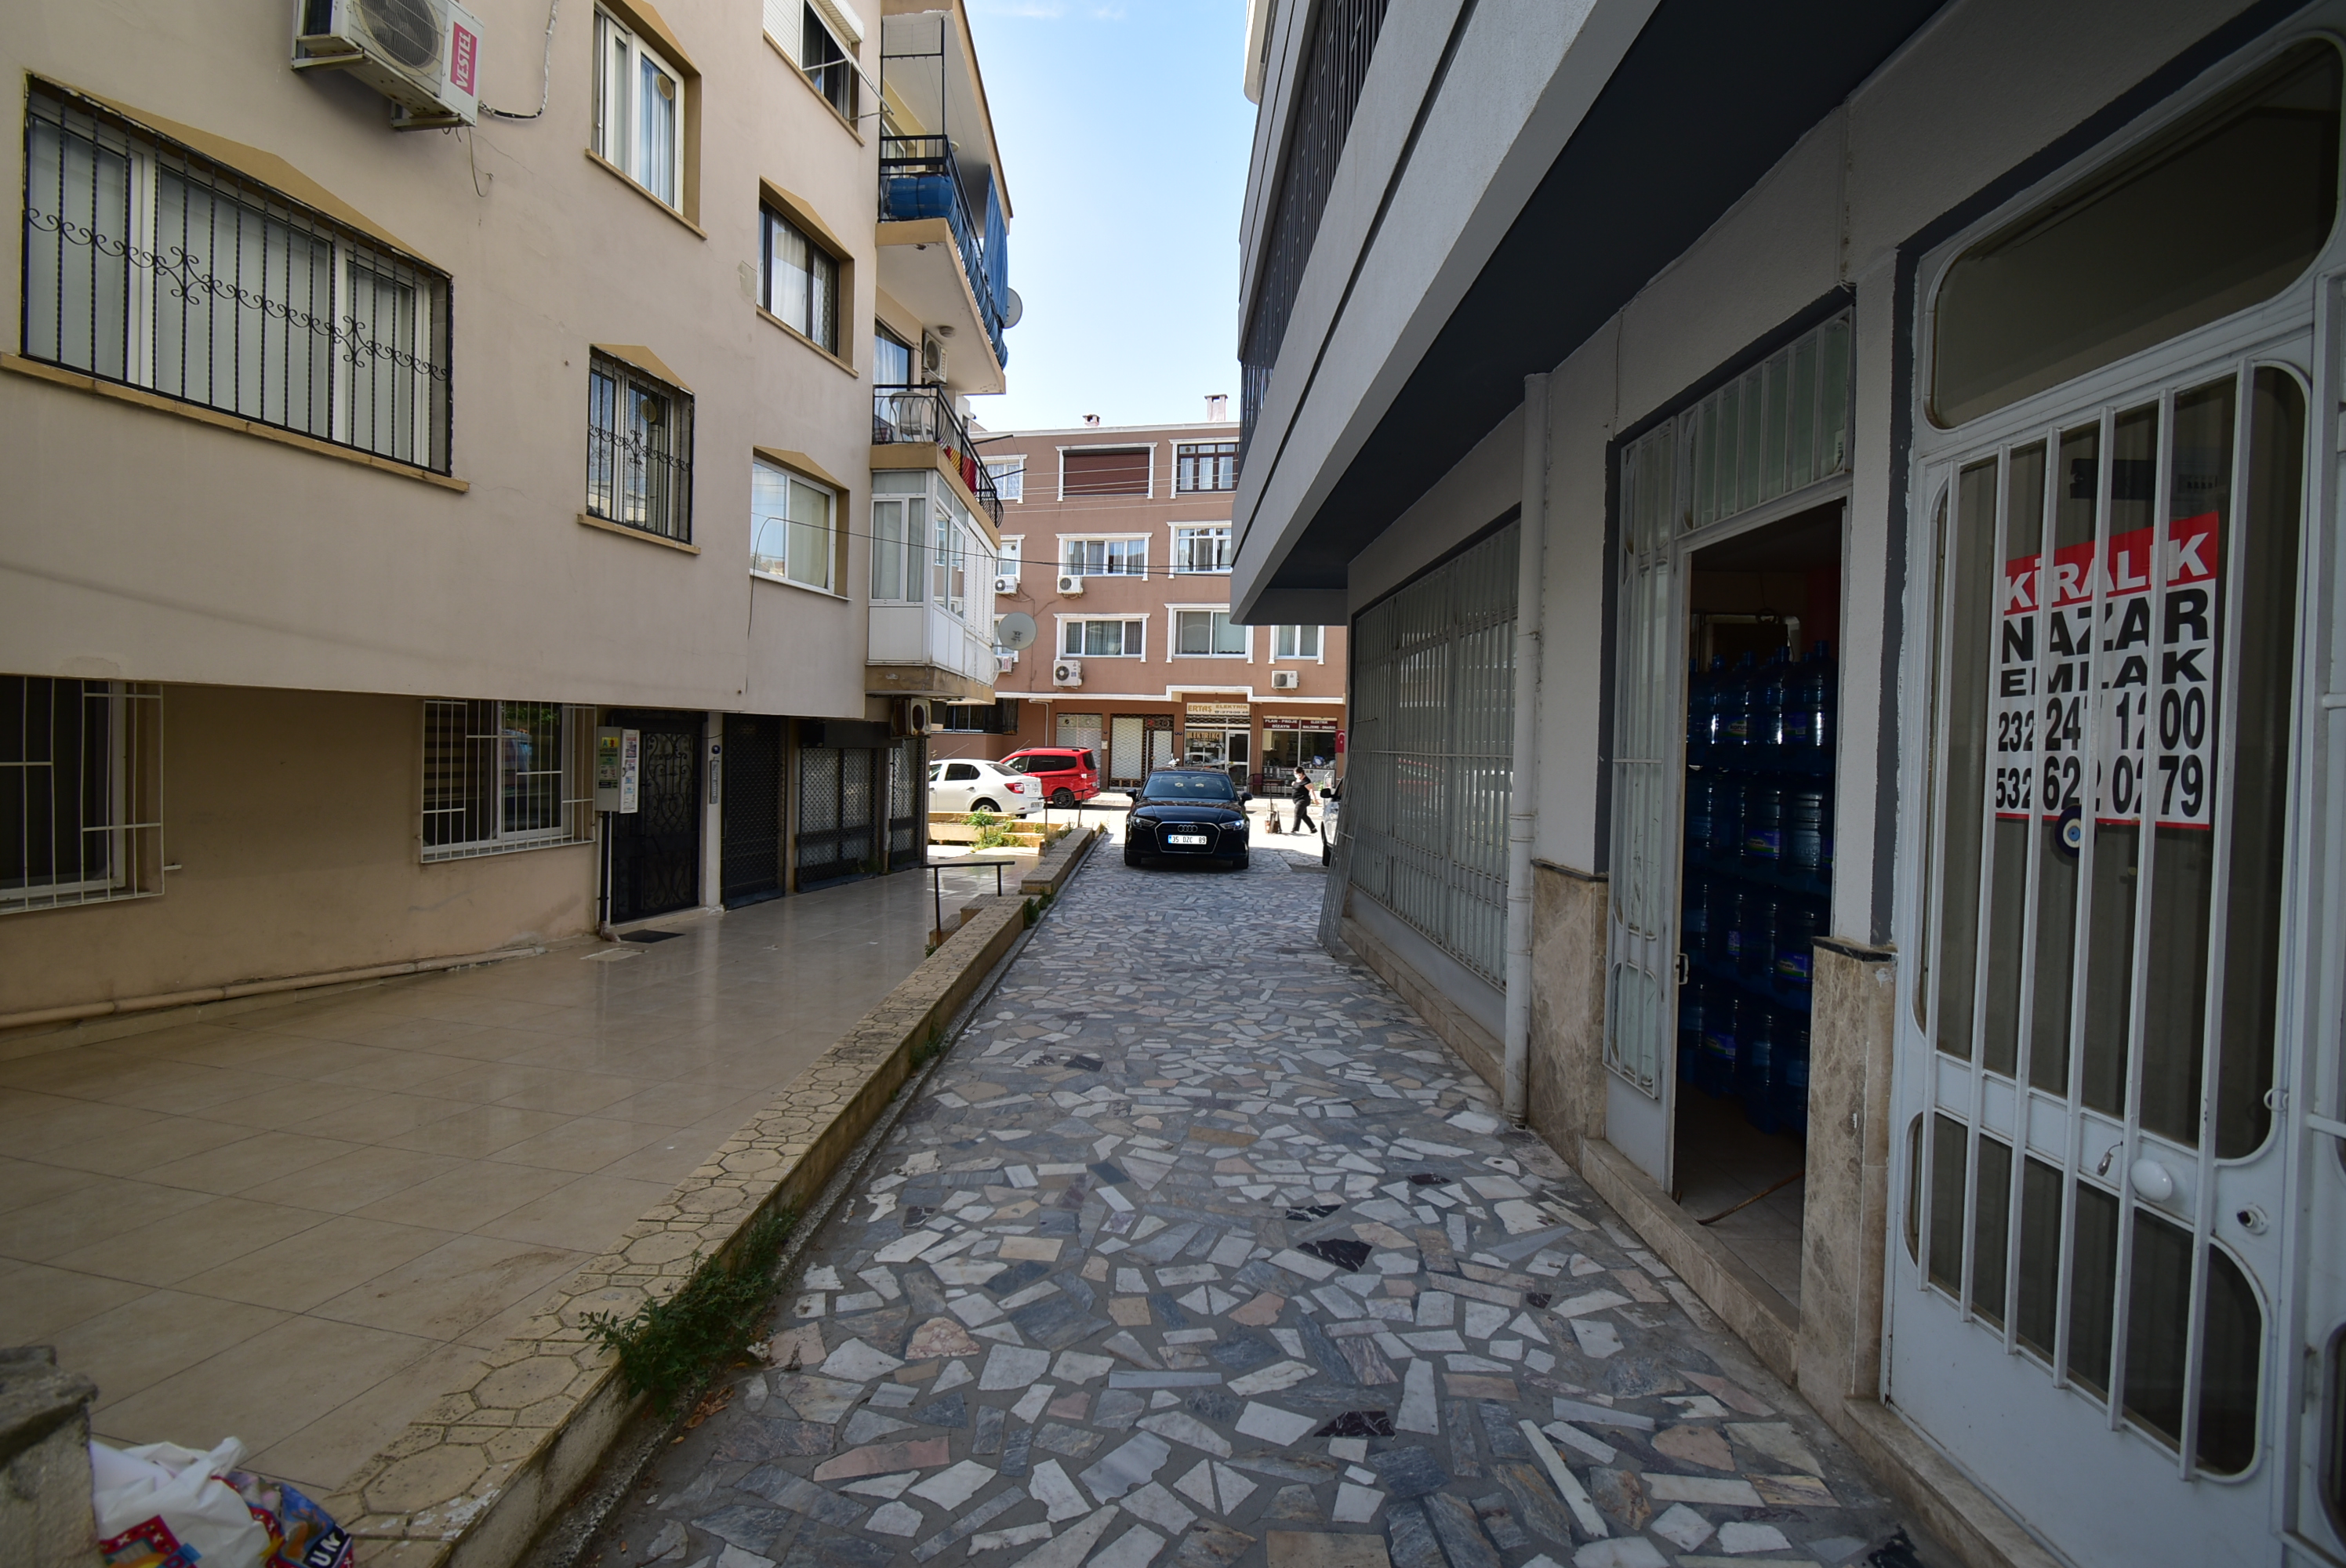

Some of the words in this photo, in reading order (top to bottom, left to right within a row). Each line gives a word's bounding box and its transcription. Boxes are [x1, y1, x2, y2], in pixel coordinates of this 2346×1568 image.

[456, 31, 471, 87] VESTEL
[2002, 588, 2209, 664] NAZAR
[1998, 710, 2035, 752] 232
[2045, 696, 2103, 751] 24
[1996, 768, 2032, 809] 532
[2043, 756, 2101, 812] 62
